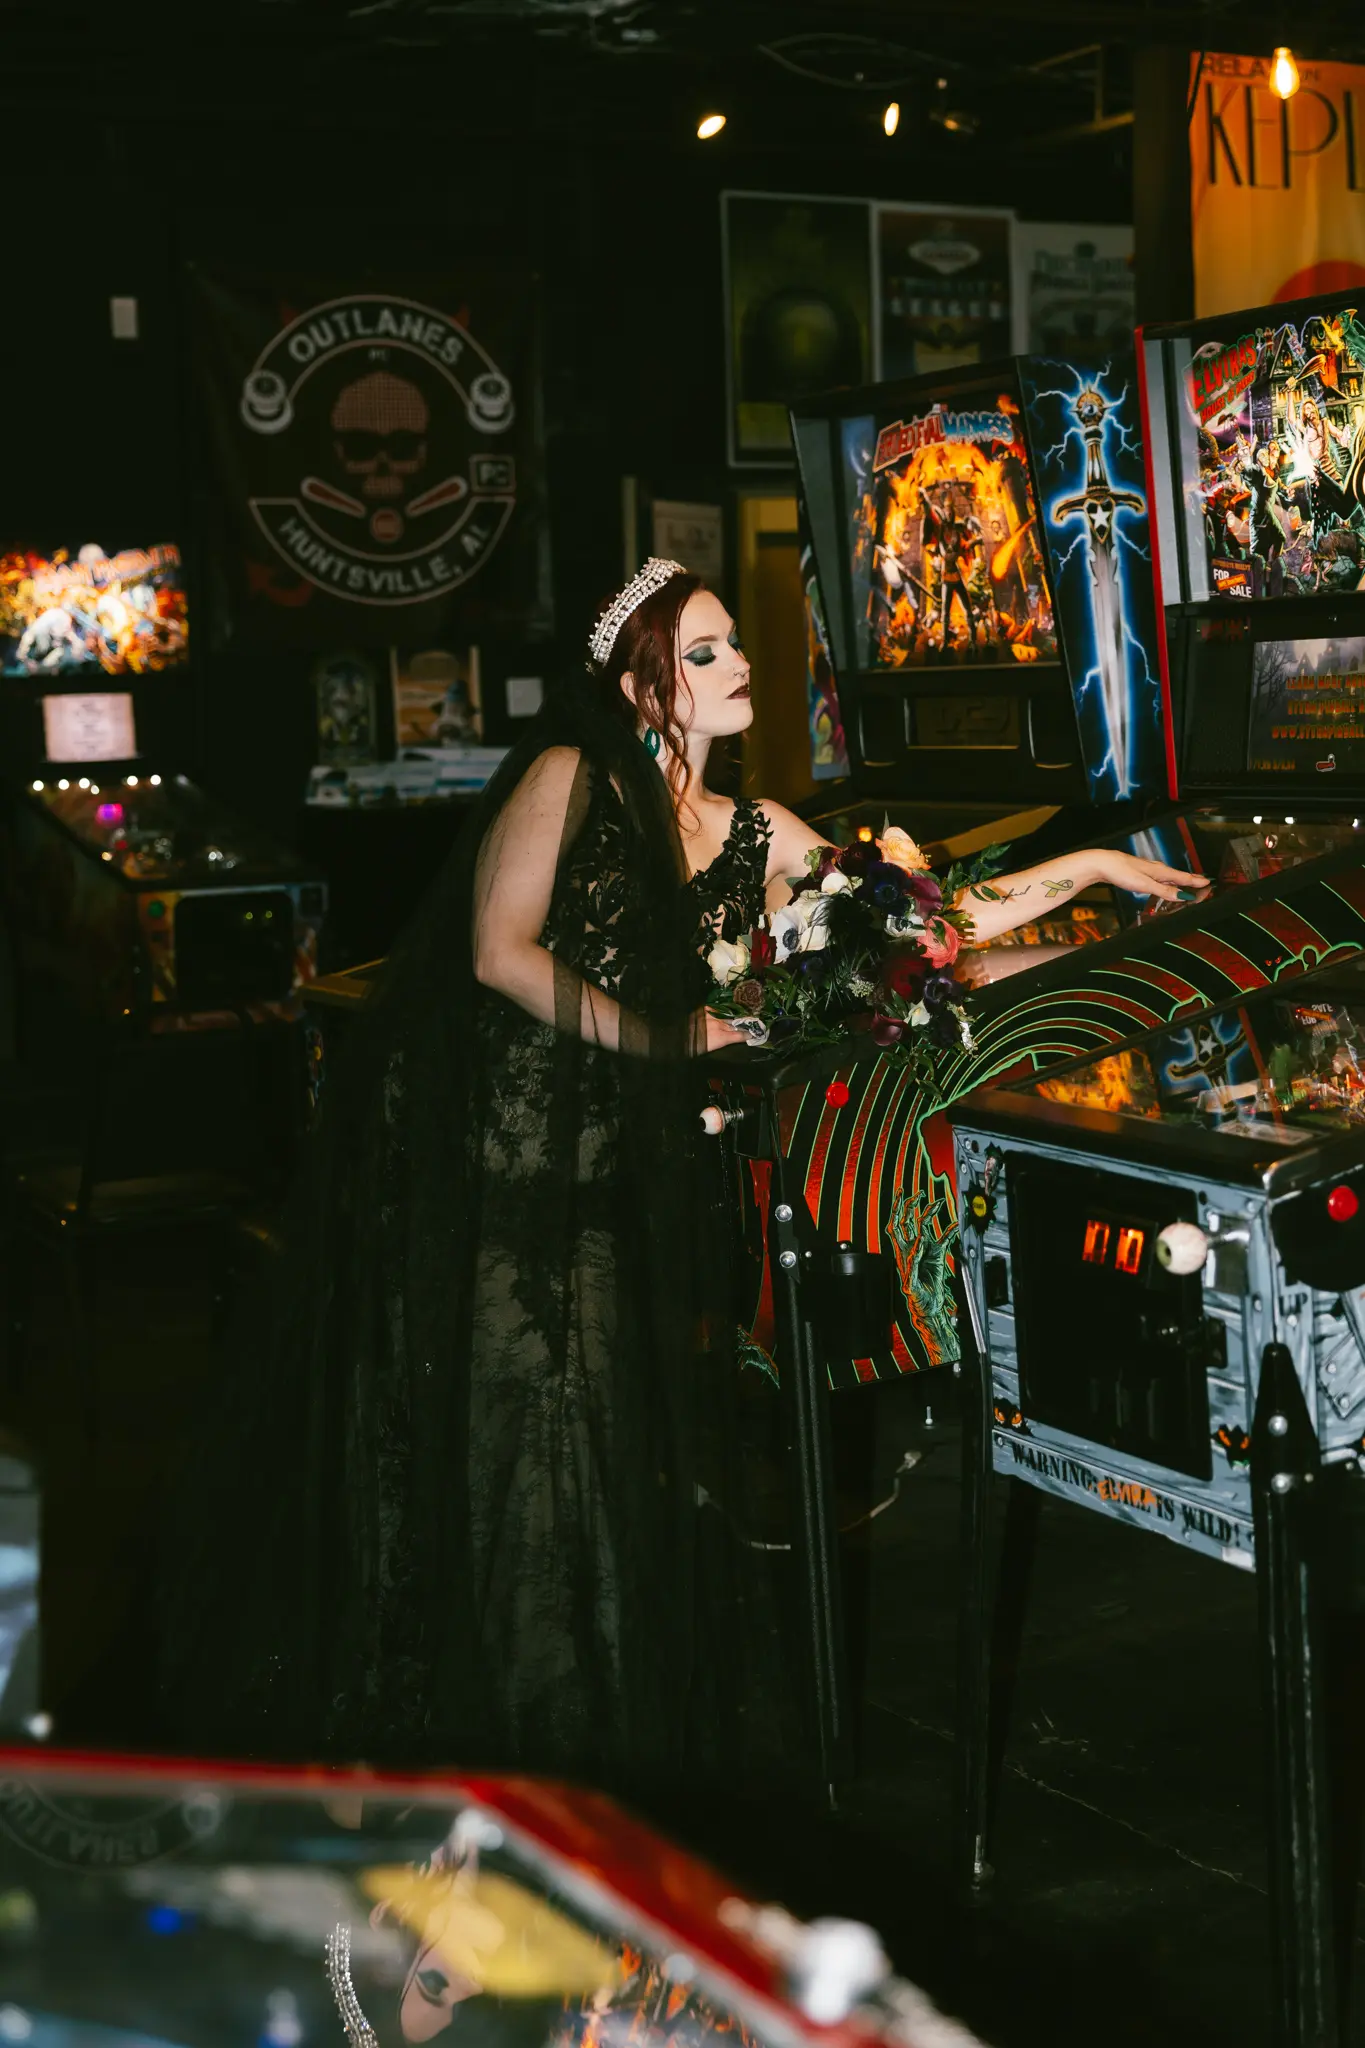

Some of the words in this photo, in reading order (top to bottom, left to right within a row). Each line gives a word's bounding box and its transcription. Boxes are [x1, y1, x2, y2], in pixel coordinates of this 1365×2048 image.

[1202, 56, 1276, 80] RELA
[288, 308, 464, 364] OUTLANES
[943, 411, 1014, 445] MADNESS
[279, 517, 465, 593] HUNTSVILLE,
[1213, 568, 1230, 581] FOR
[1229, 584, 1252, 598] SALE
[1011, 1441, 1098, 1493] WARNING:
[1156, 1494, 1175, 1521] IS
[1182, 1504, 1240, 1547] WILD!
